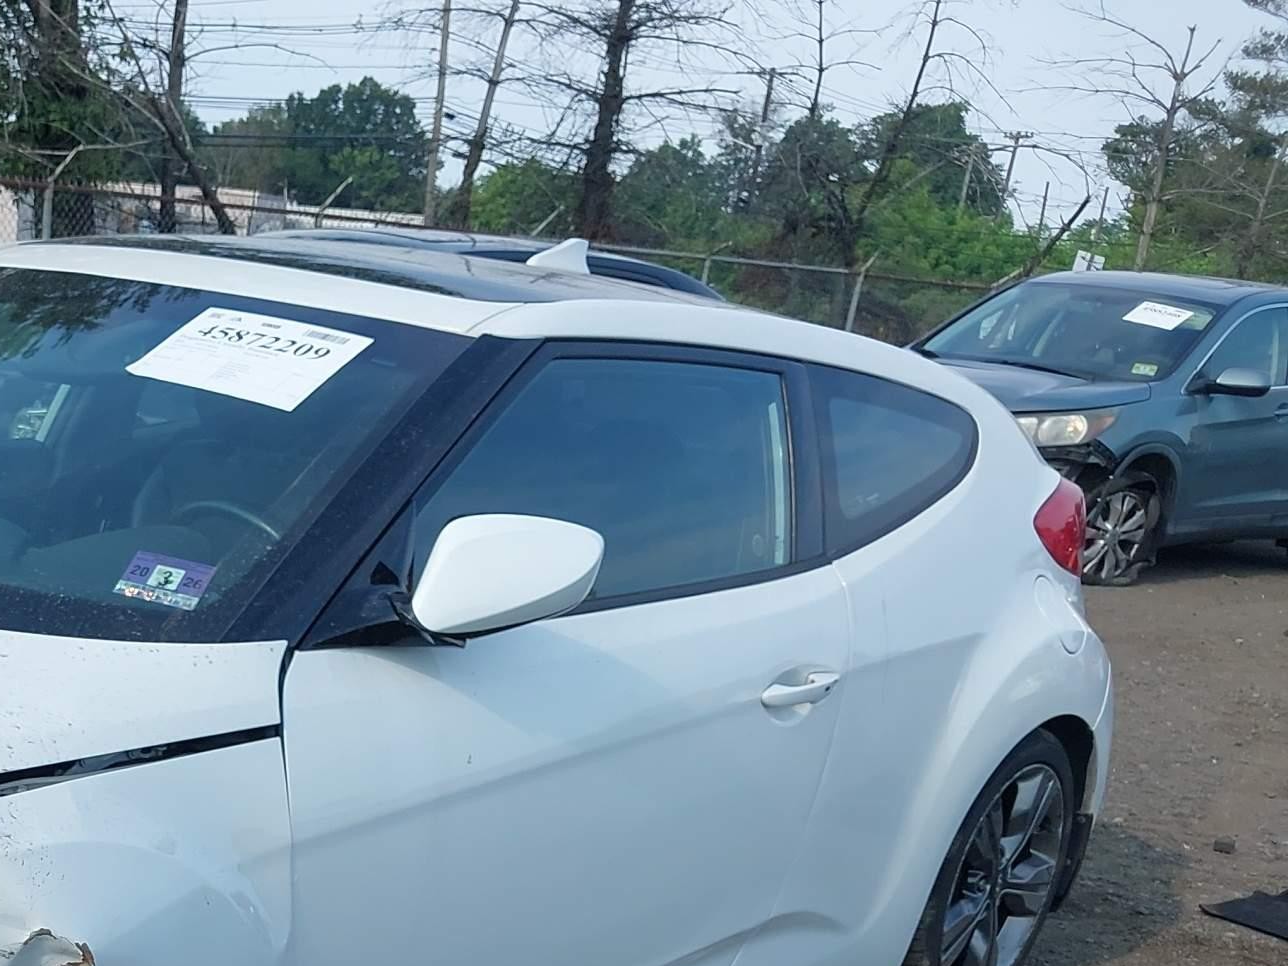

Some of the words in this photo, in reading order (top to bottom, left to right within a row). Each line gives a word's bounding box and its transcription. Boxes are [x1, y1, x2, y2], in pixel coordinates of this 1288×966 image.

[198, 324, 331, 360] 45872209
[129, 564, 150, 578] 20
[158, 570, 174, 587] 3
[182, 577, 204, 590] 26
